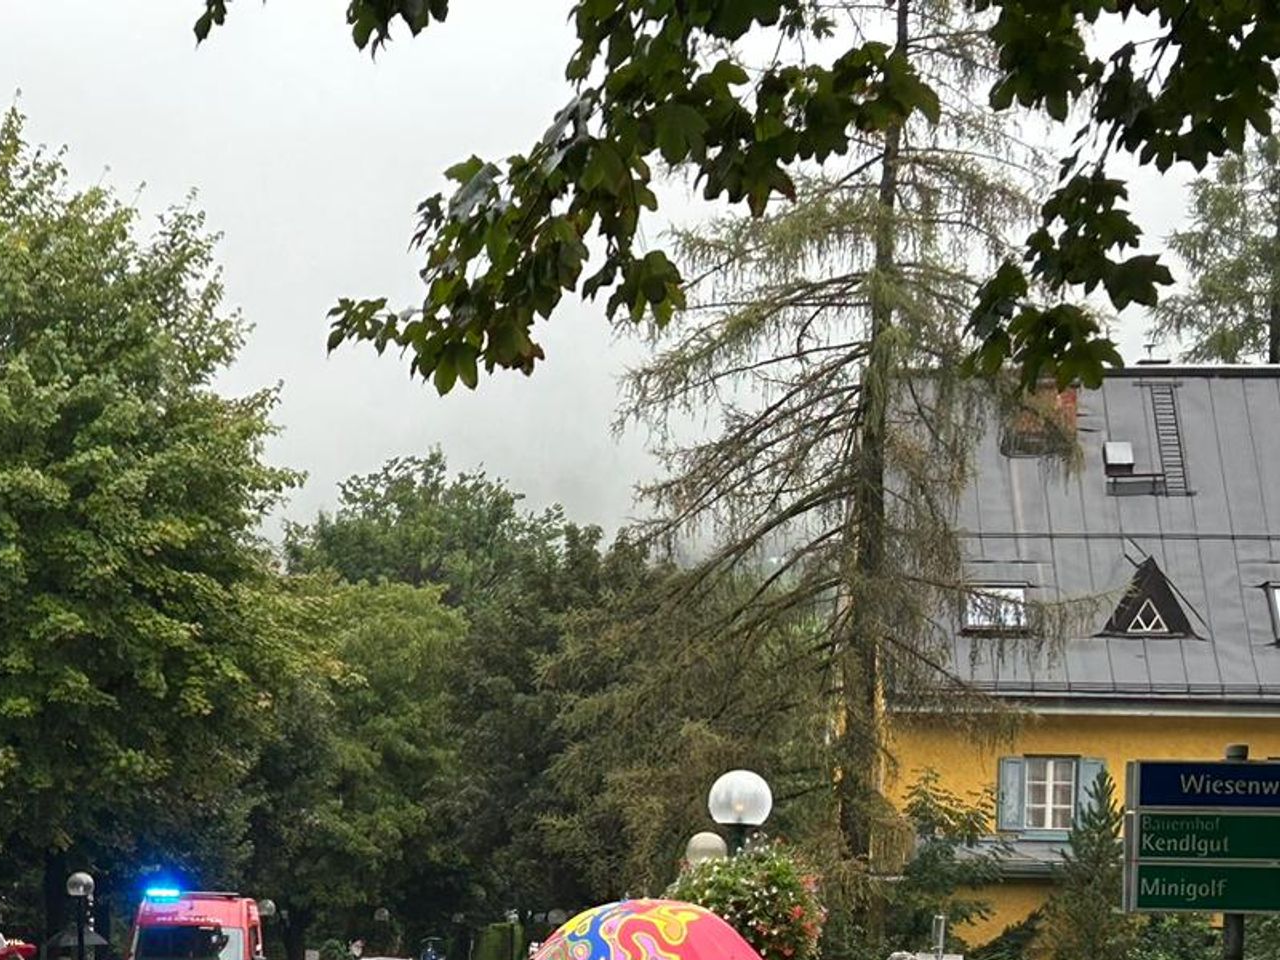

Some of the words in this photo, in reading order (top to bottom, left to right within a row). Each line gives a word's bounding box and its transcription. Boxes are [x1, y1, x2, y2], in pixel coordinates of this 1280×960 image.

[1180, 773, 1280, 795] Wiesenw
[1141, 815, 1221, 831] Bauernhof
[1141, 833, 1230, 856] Kendlgut
[1140, 877, 1228, 901] Minigolf
